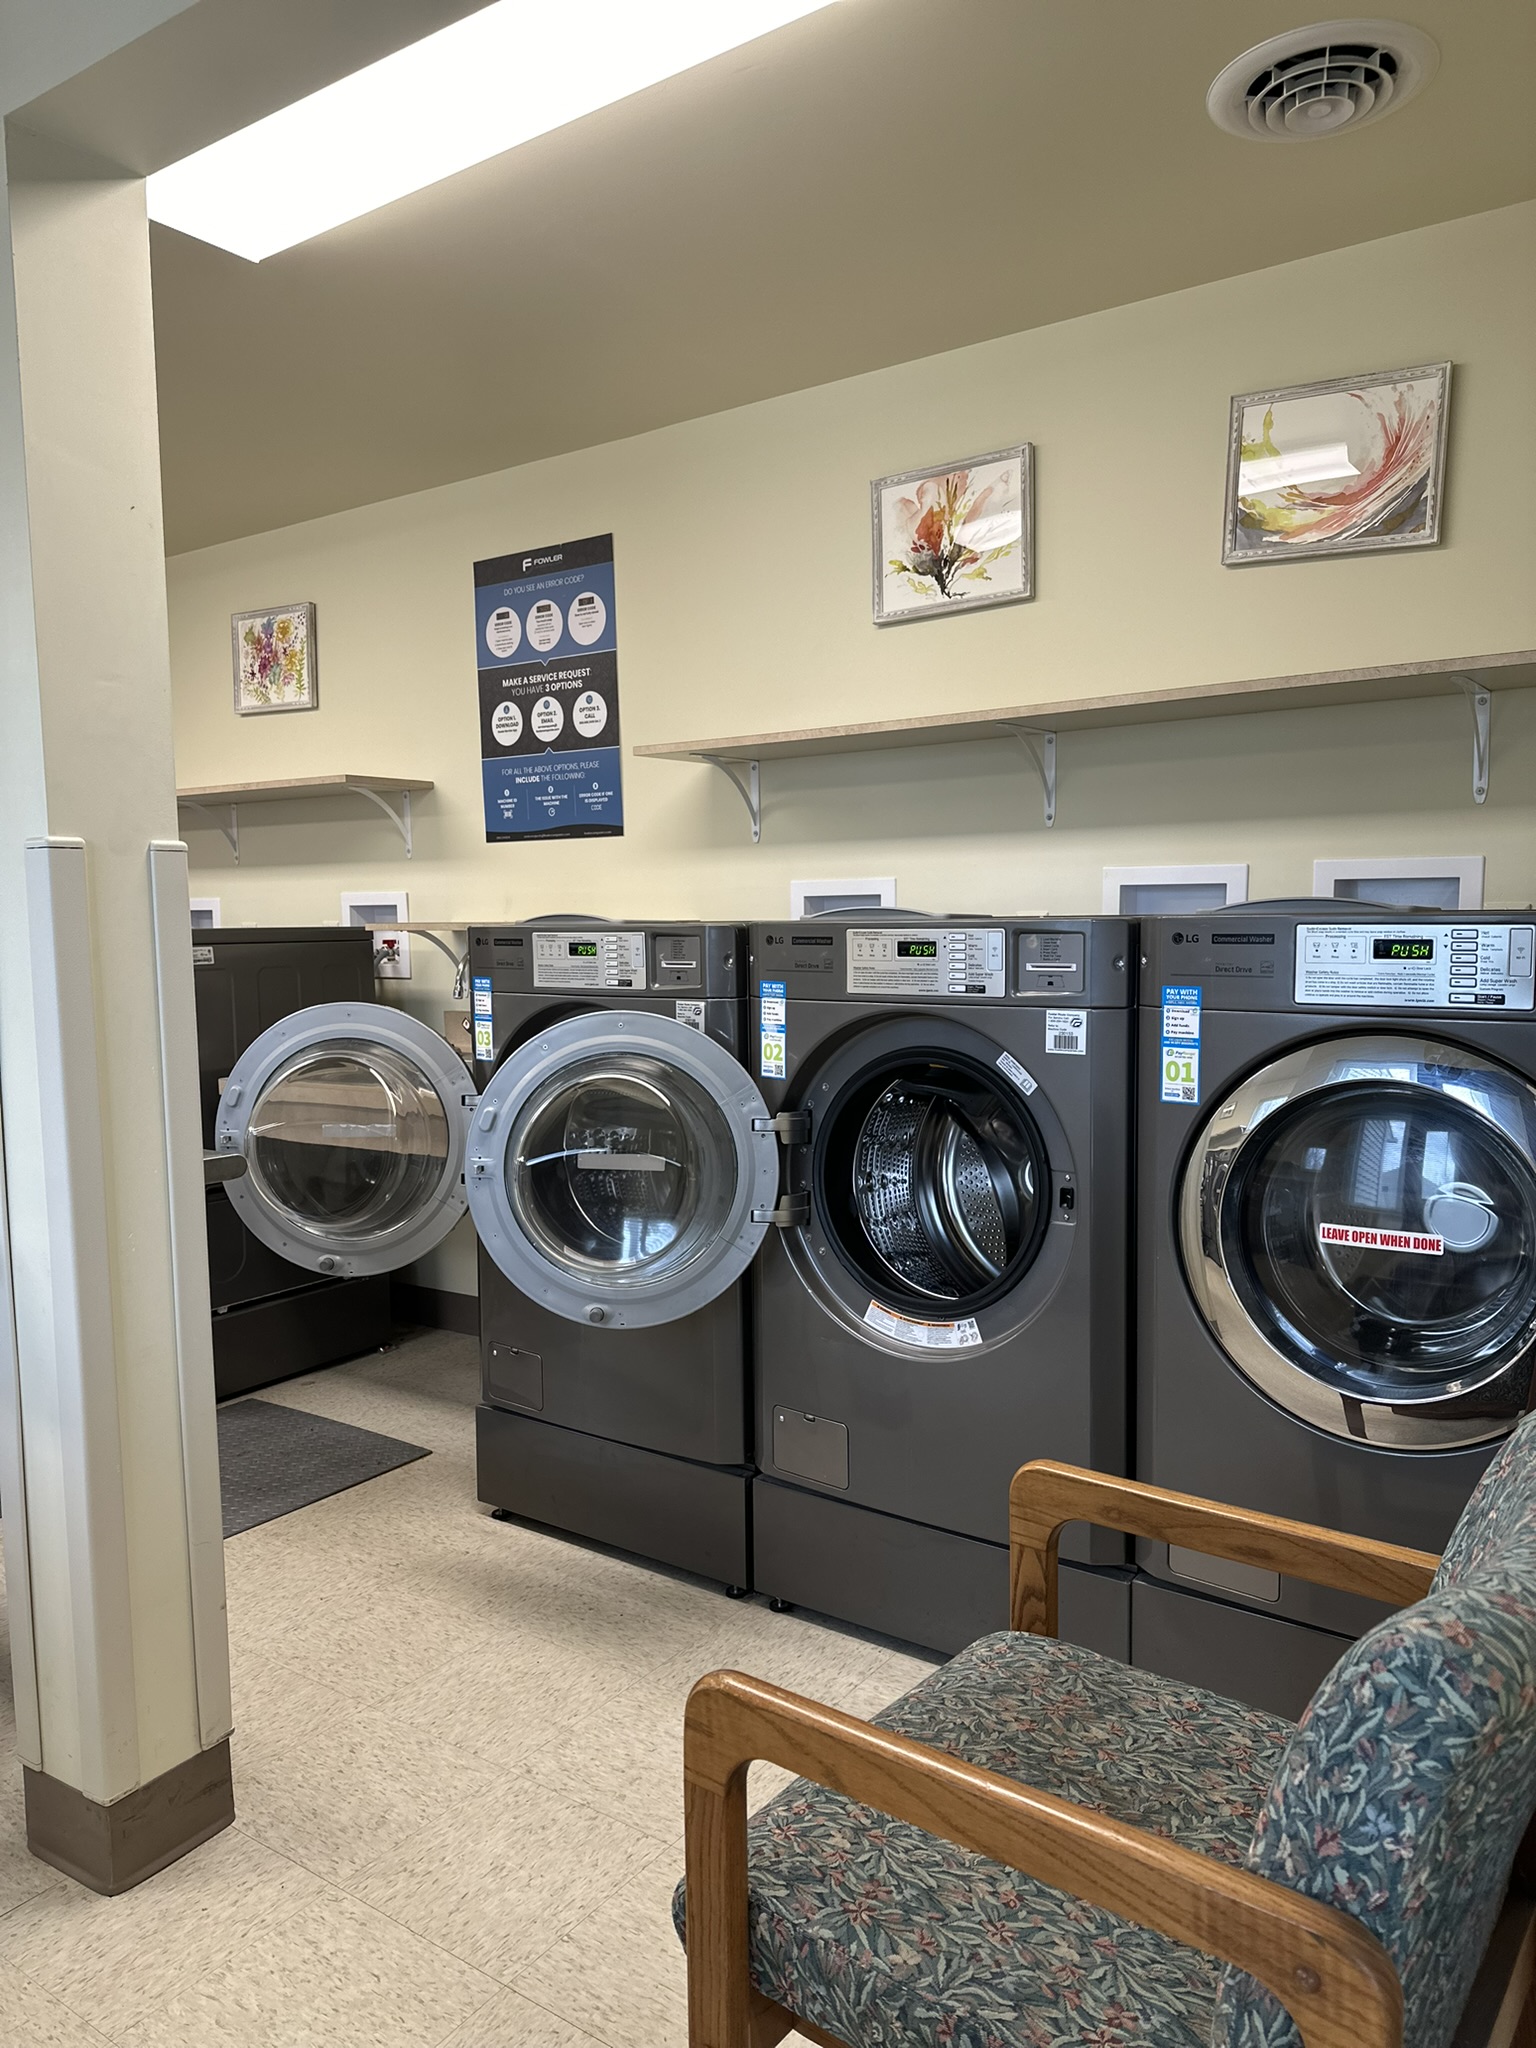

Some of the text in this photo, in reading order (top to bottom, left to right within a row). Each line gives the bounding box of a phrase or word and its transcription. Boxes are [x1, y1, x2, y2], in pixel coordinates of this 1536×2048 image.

[534, 554, 563, 565] FOWLER
[504, 588, 513, 596] DO
[526, 583, 535, 592] SEE
[546, 579, 563, 588] ERROR
[564, 574, 584, 585] CODE?
[502, 678, 522, 687] MAKE
[529, 672, 557, 684] SERVICE
[511, 680, 583, 696] YOU HAVE 3 OPTIONS
[534, 764, 552, 773] ABOVE
[515, 775, 540, 784] INCLUDE
[1185, 934, 1200, 943] LG
[578, 946, 596, 954] PUSH
[909, 945, 935, 955] PUSH
[1391, 945, 1429, 957] PUSH
[477, 1031, 491, 1046] 03
[763, 1043, 783, 1061] 02
[1166, 1060, 1195, 1083] 01
[1322, 1227, 1442, 1252] LEAVE OPEN WHEN DONE
